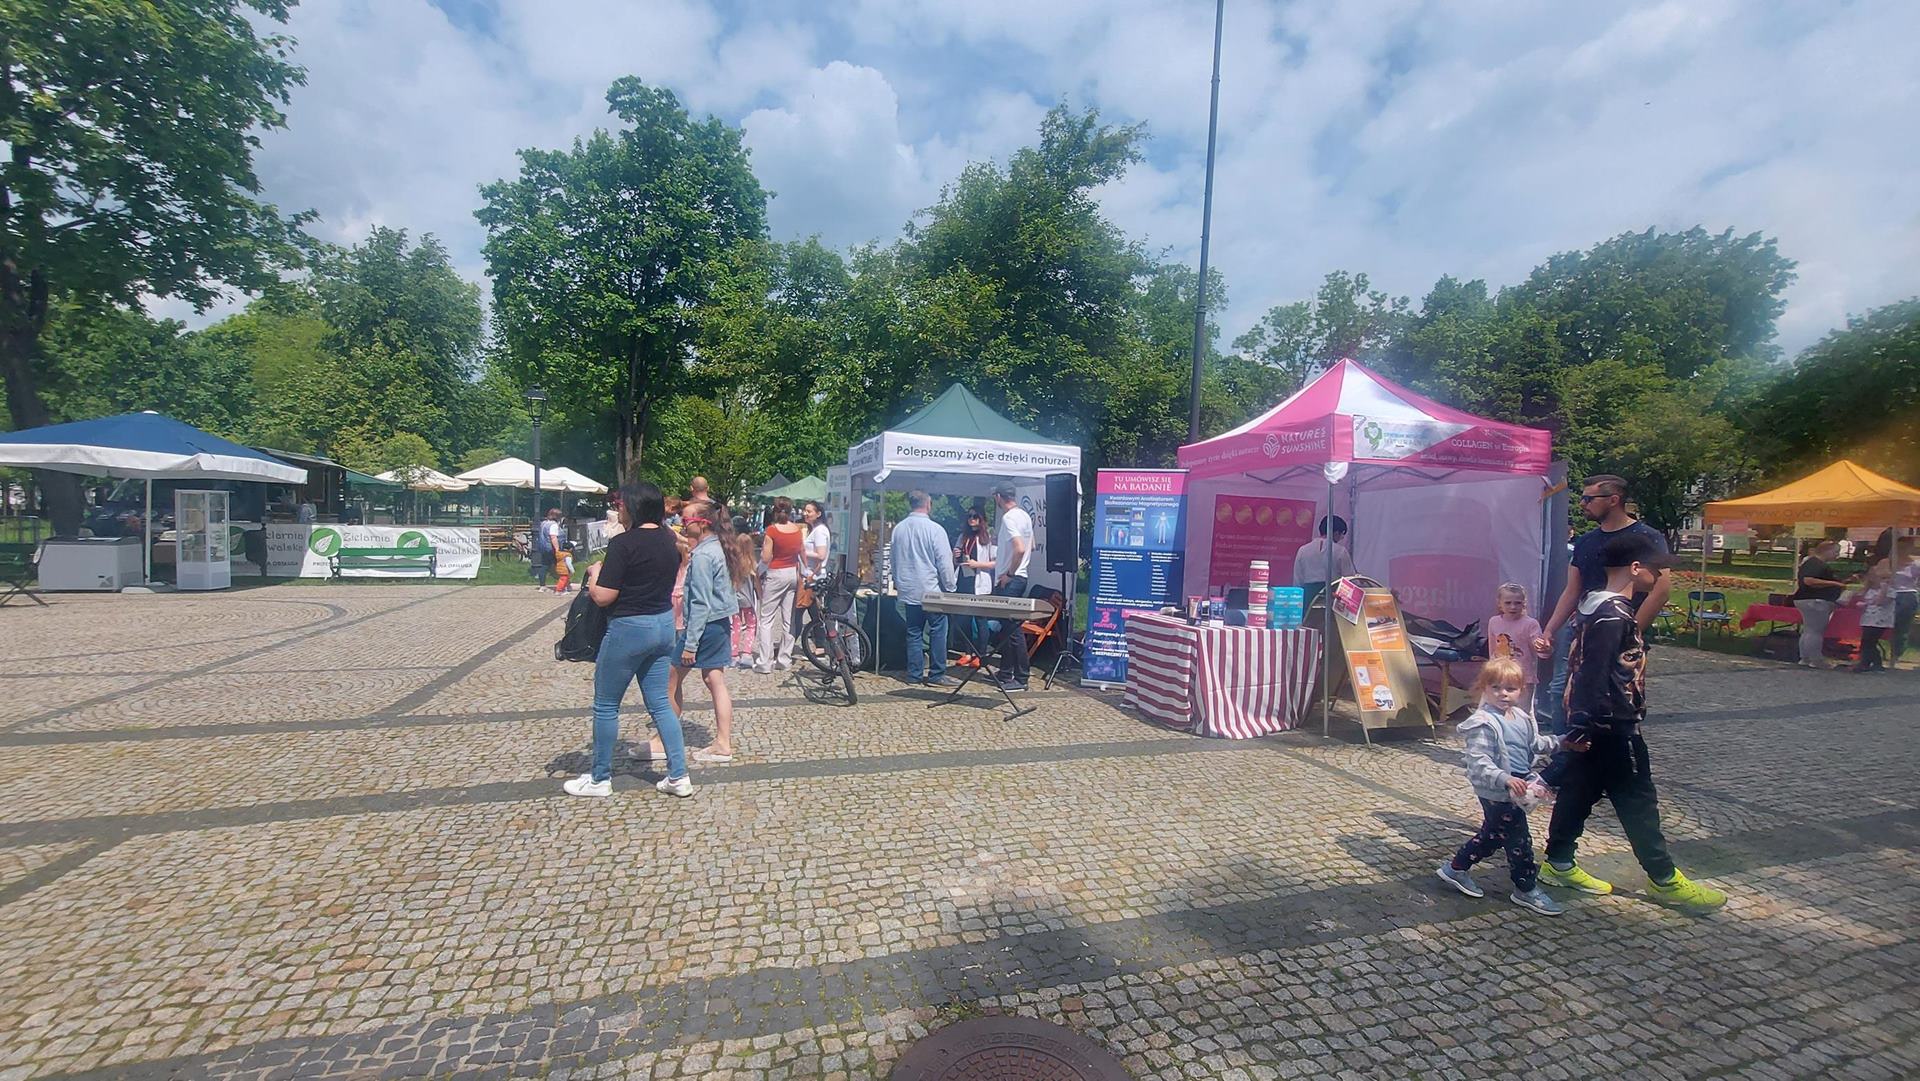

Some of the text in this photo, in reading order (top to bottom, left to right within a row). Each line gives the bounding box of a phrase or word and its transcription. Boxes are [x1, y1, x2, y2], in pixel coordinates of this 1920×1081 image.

[1281, 440, 1326, 454] SUNSHINE
[1451, 438, 1493, 449] COLLAGEN
[896, 444, 1072, 467] Polepszamy życie dzięki naturze!
[1125, 475, 1159, 483] UMÓWISZ
[1113, 483, 1172, 492] NA BADANIE
[343, 532, 391, 543] Zielarnia
[1101, 611, 1110, 623] 3
